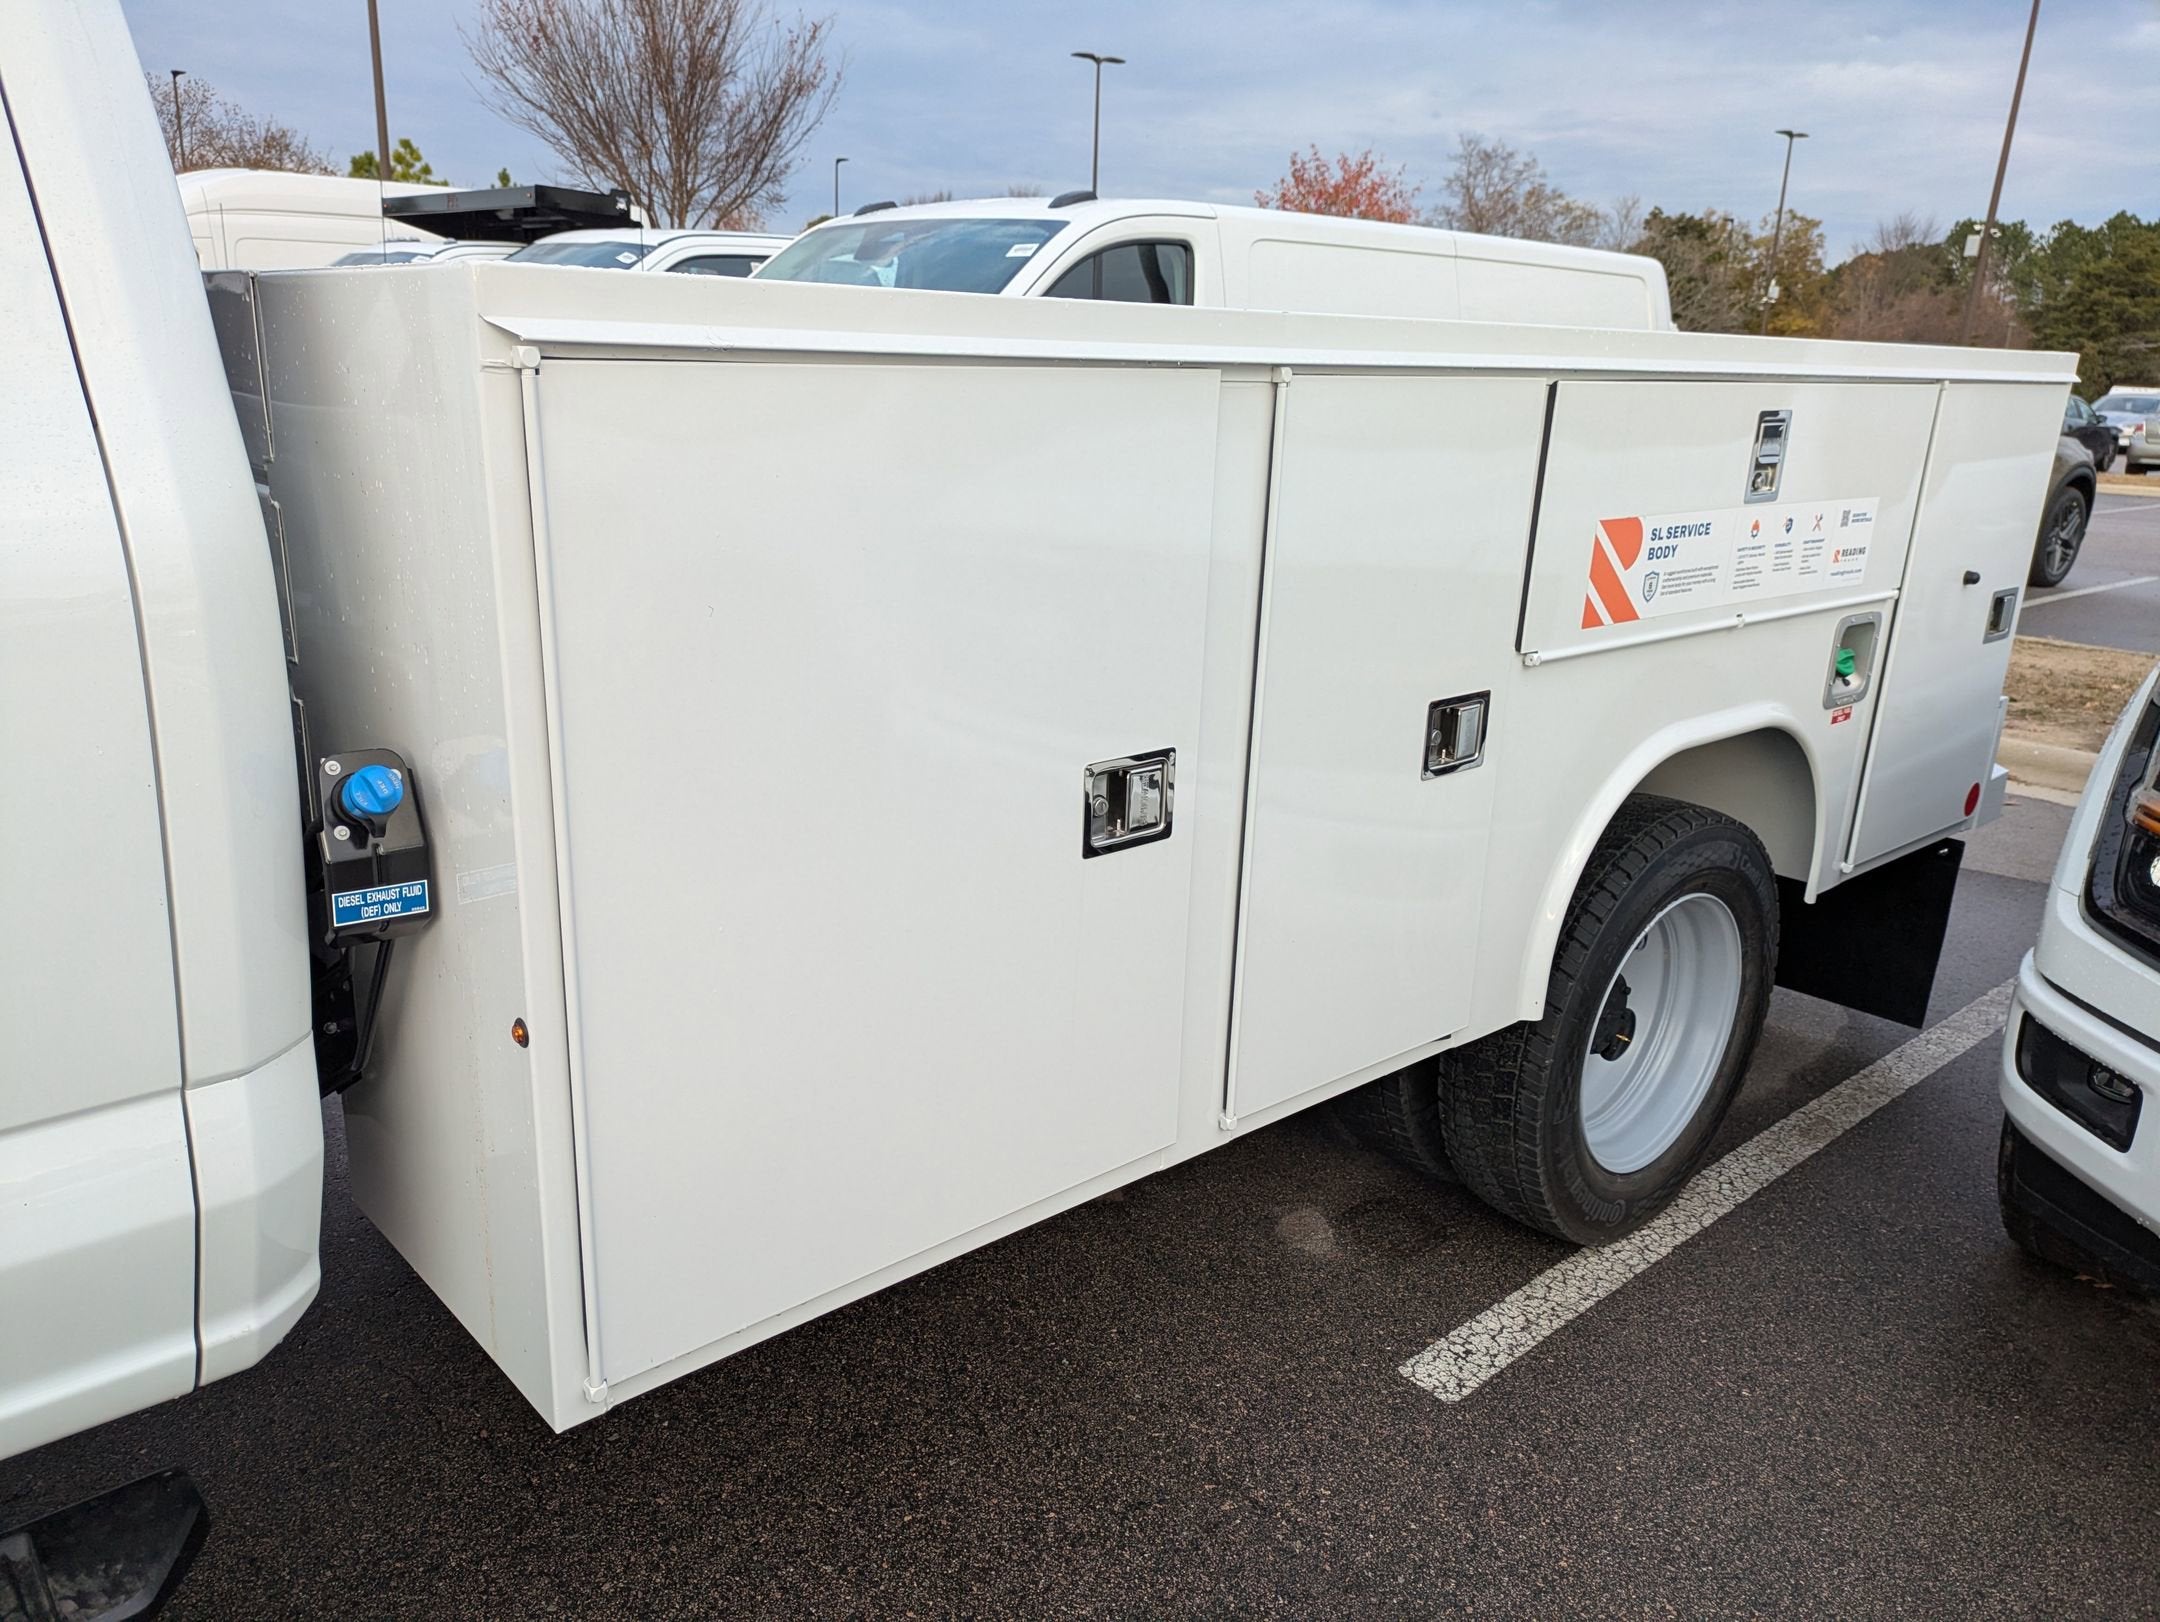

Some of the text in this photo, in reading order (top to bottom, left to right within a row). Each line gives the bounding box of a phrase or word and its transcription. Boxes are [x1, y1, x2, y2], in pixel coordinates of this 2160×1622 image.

[1650, 522, 1712, 541] SL SERVICE
[1647, 544, 1679, 561] BODY
[1841, 546, 1867, 558] READING
[338, 884, 423, 908] DIESEL EXHAUST FLUID
[361, 901, 402, 919] (DEF) ONLY
